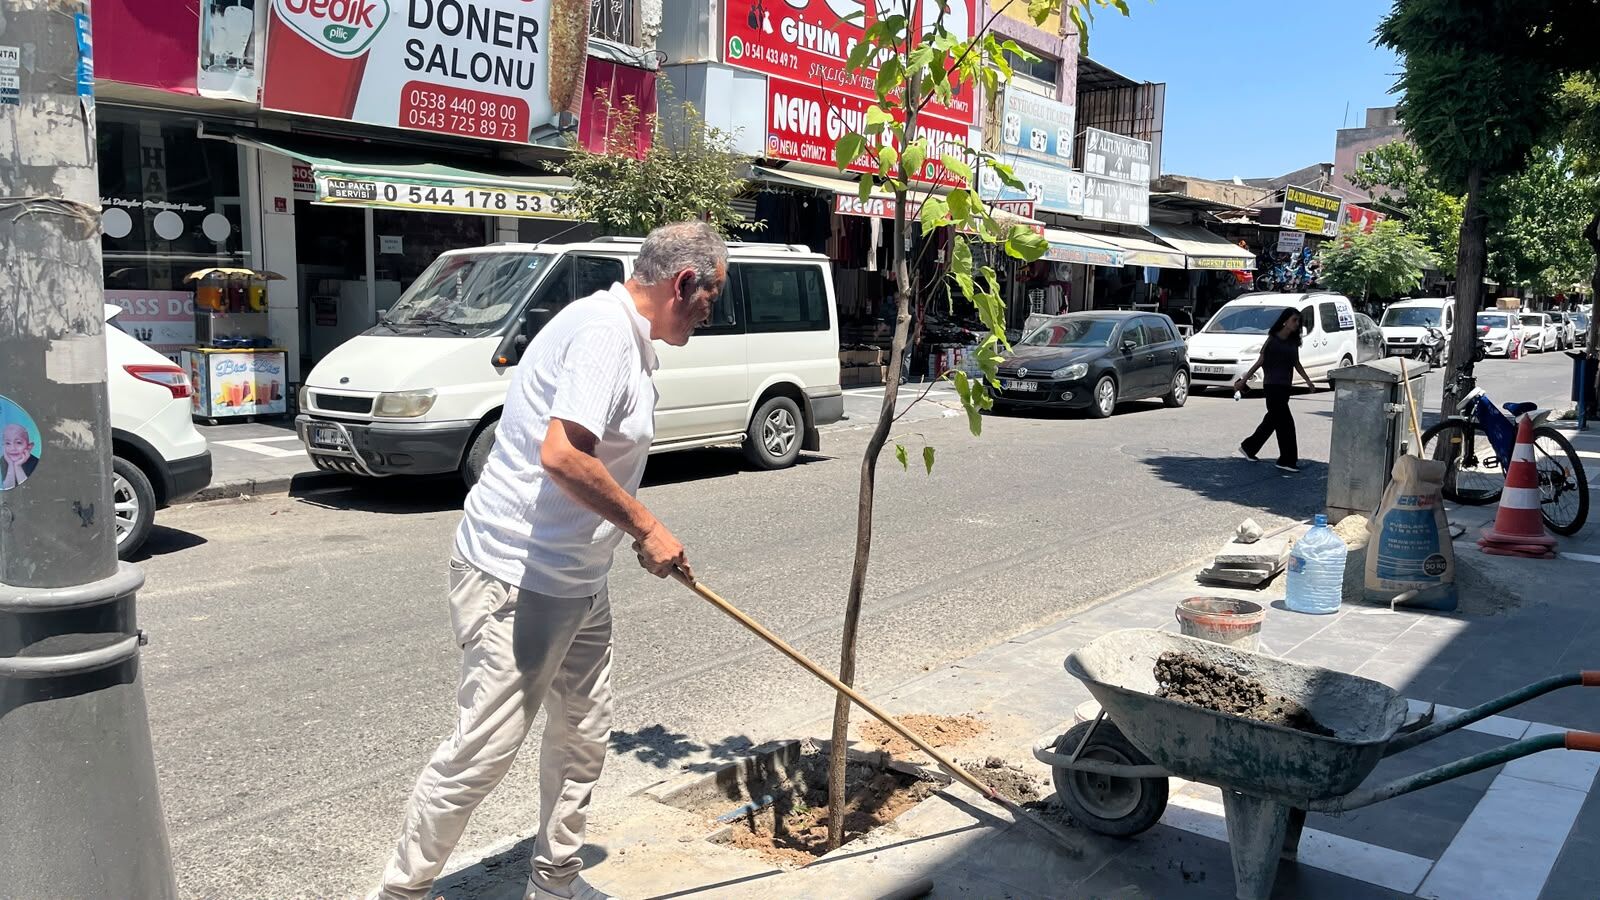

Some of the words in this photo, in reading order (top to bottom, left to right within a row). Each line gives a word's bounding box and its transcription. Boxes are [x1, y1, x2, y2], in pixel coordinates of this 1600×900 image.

[329, 27, 348, 40] piliç
[781, 14, 840, 57] GİYİM
[404, 38, 535, 90] SALONU
[745, 42, 750, 56] 0
[752, 44, 763, 60] 541
[766, 48, 778, 64] 433
[780, 53, 788, 67] 49
[790, 55, 798, 69] 72
[410, 89, 446, 110] 0538
[449, 97, 476, 115] 440
[479, 101, 496, 118] 98
[500, 104, 516, 121] 00
[774, 93, 821, 137] NEVA
[409, 109, 445, 129] 0543
[450, 115, 475, 132] 725
[480, 120, 496, 135] 89
[501, 122, 516, 138] 73
[328, 181, 346, 189] ALO
[349, 183, 375, 191] PAKET
[384, 185, 397, 202] 0
[409, 186, 455, 206] 544
[465, 191, 507, 209] 178
[516, 195, 542, 212] 53
[839, 194, 884, 215] NEVA
